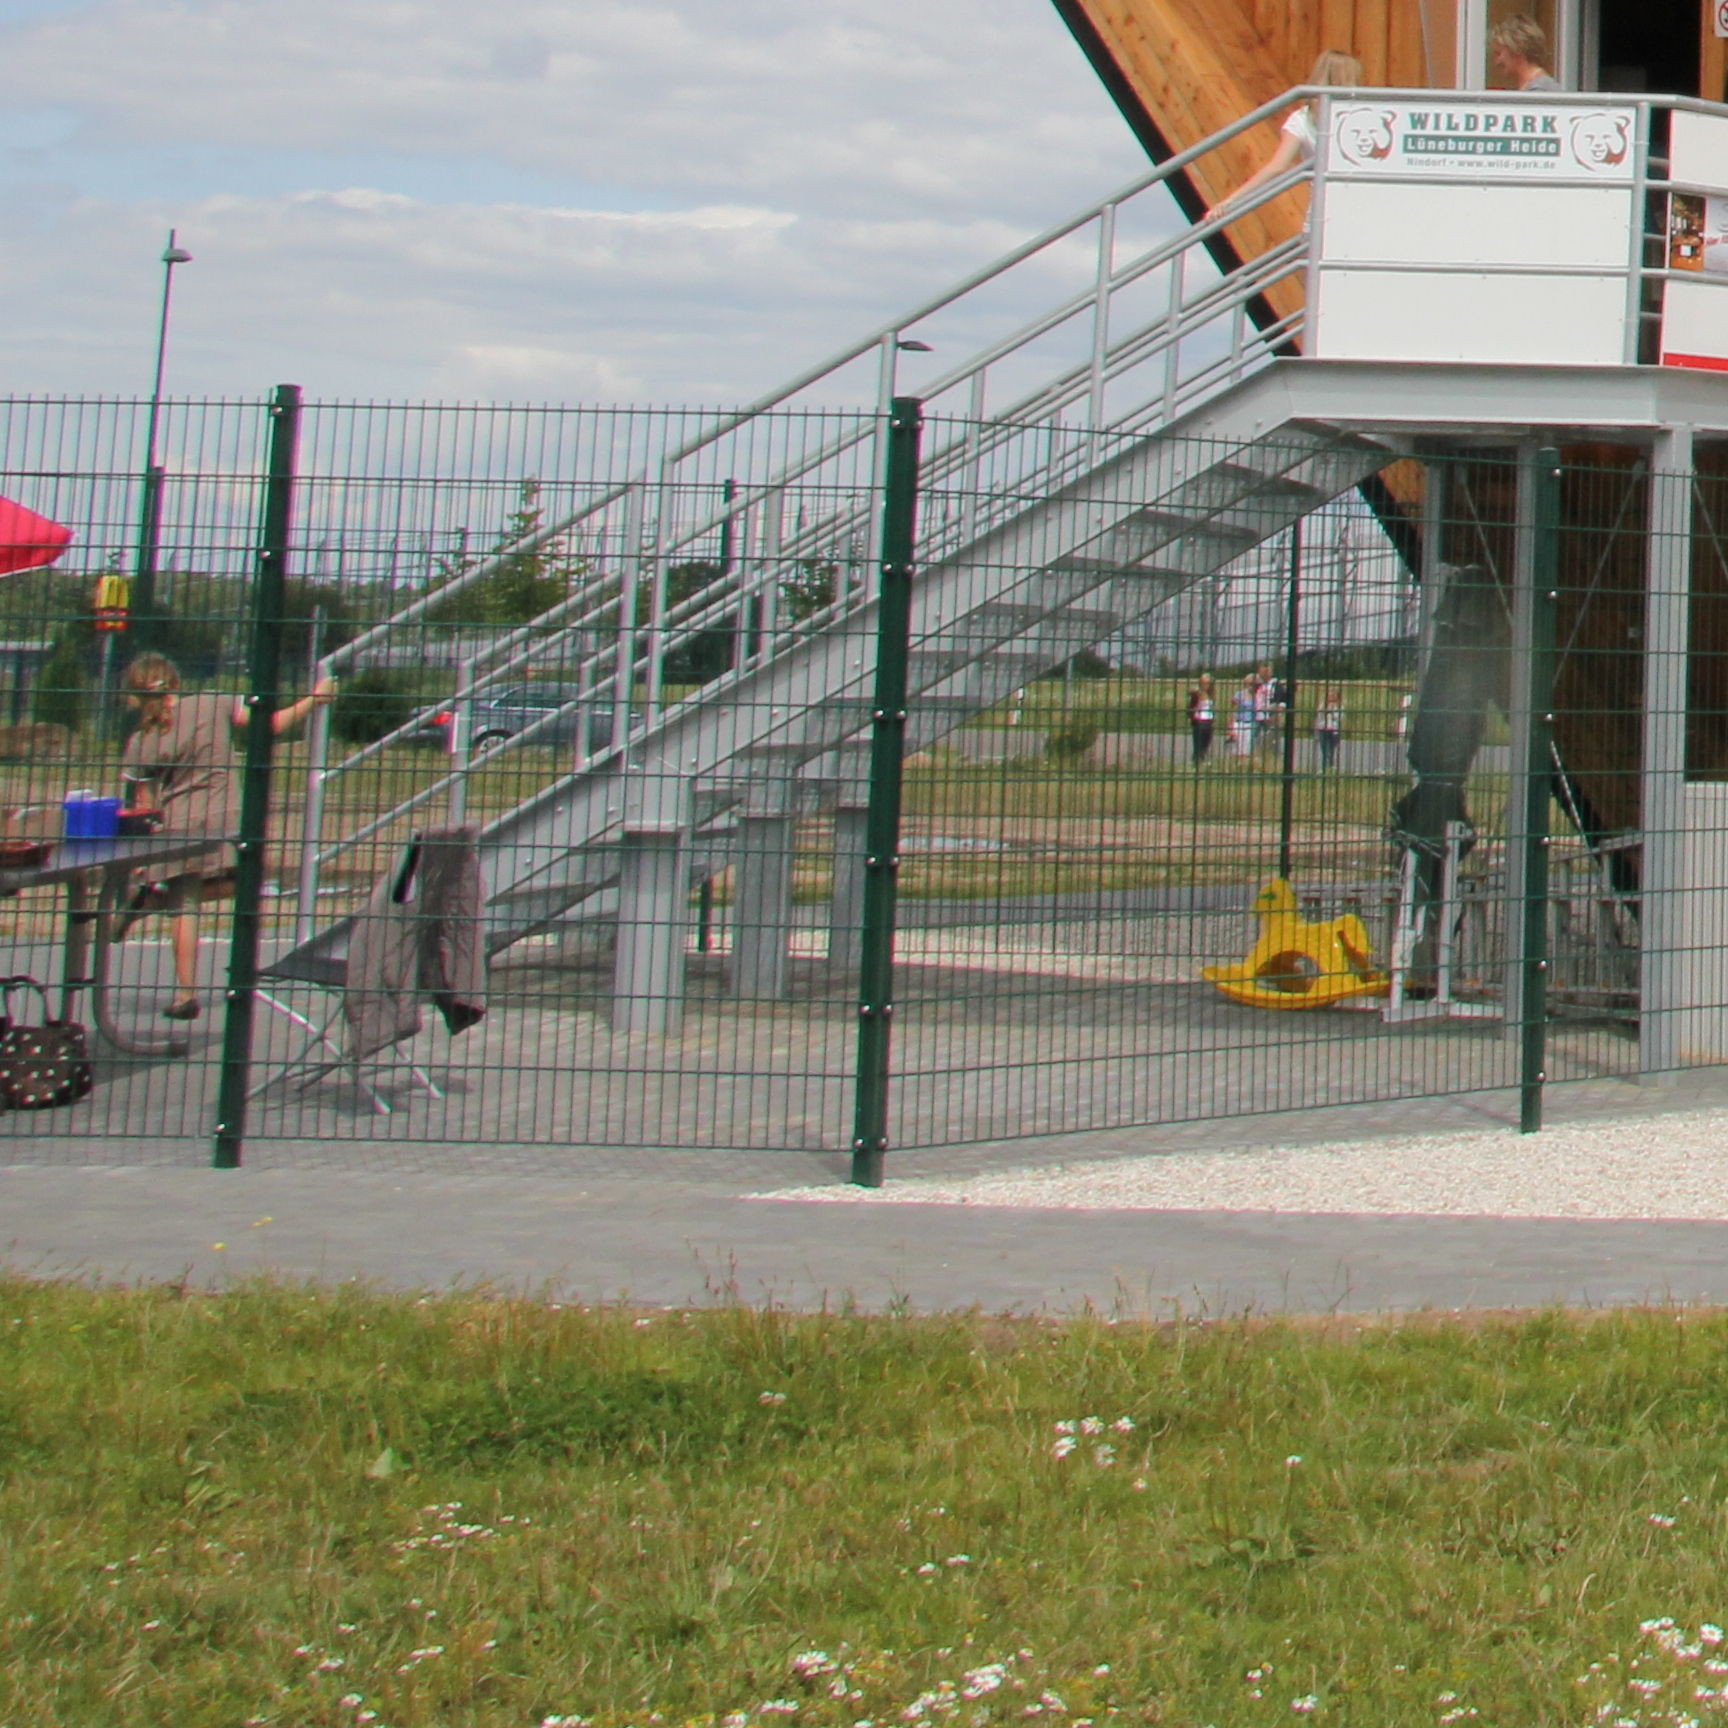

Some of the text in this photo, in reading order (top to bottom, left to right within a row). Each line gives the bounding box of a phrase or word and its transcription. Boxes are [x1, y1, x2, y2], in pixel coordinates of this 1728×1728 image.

[1408, 111, 1558, 134] WILDPARK
[1406, 137, 1557, 154] Lüneburger Heide
[1406, 157, 1556, 170] Nindorf www.wild-park.de
